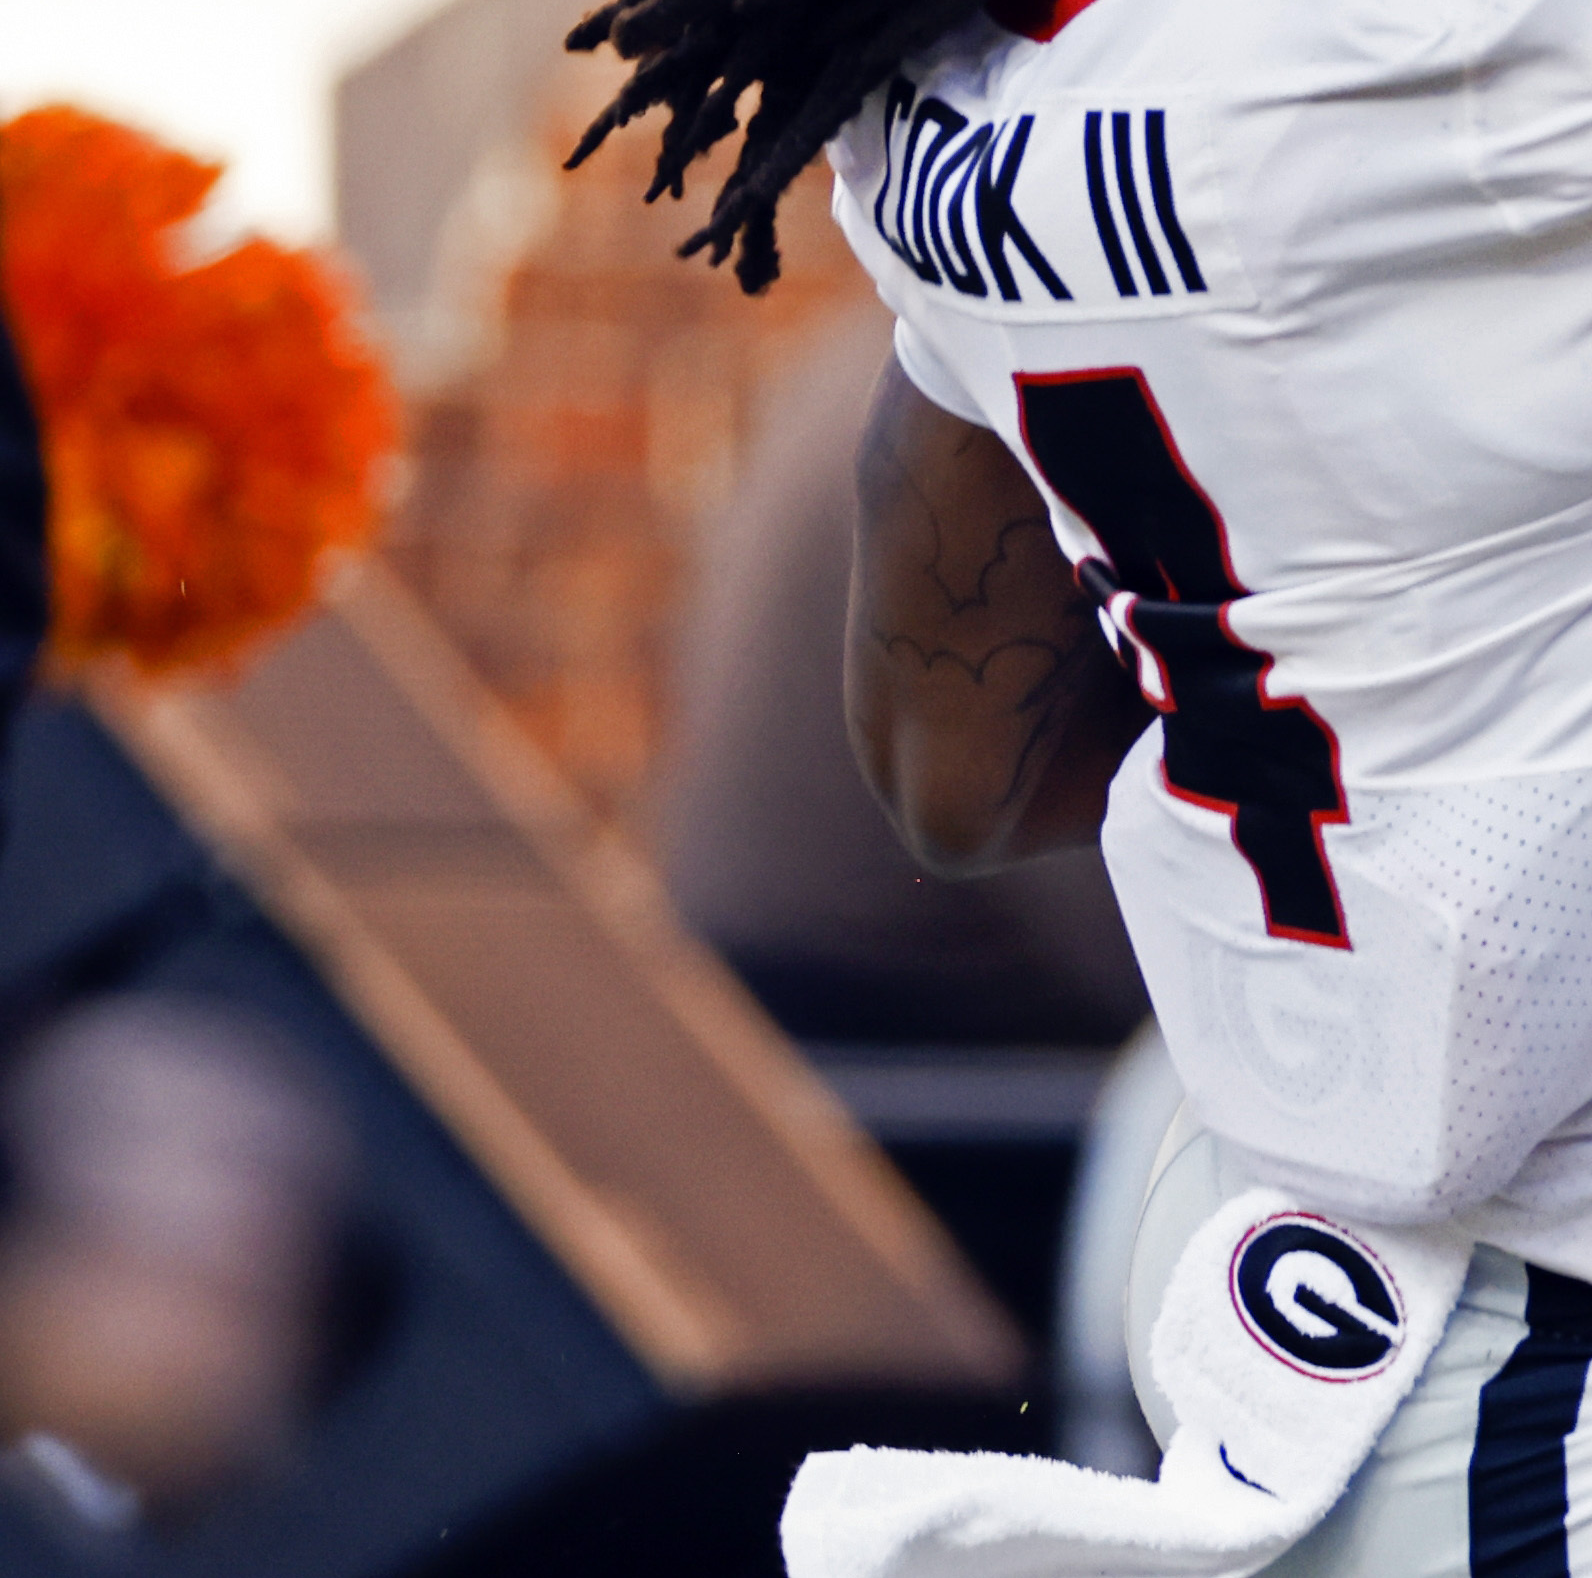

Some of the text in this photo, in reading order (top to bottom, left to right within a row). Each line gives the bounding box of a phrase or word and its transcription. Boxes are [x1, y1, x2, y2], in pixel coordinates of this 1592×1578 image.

[874, 76, 1208, 302] COOK III
[1012, 365, 1353, 952] 4
[1237, 1223, 1400, 1370] G
